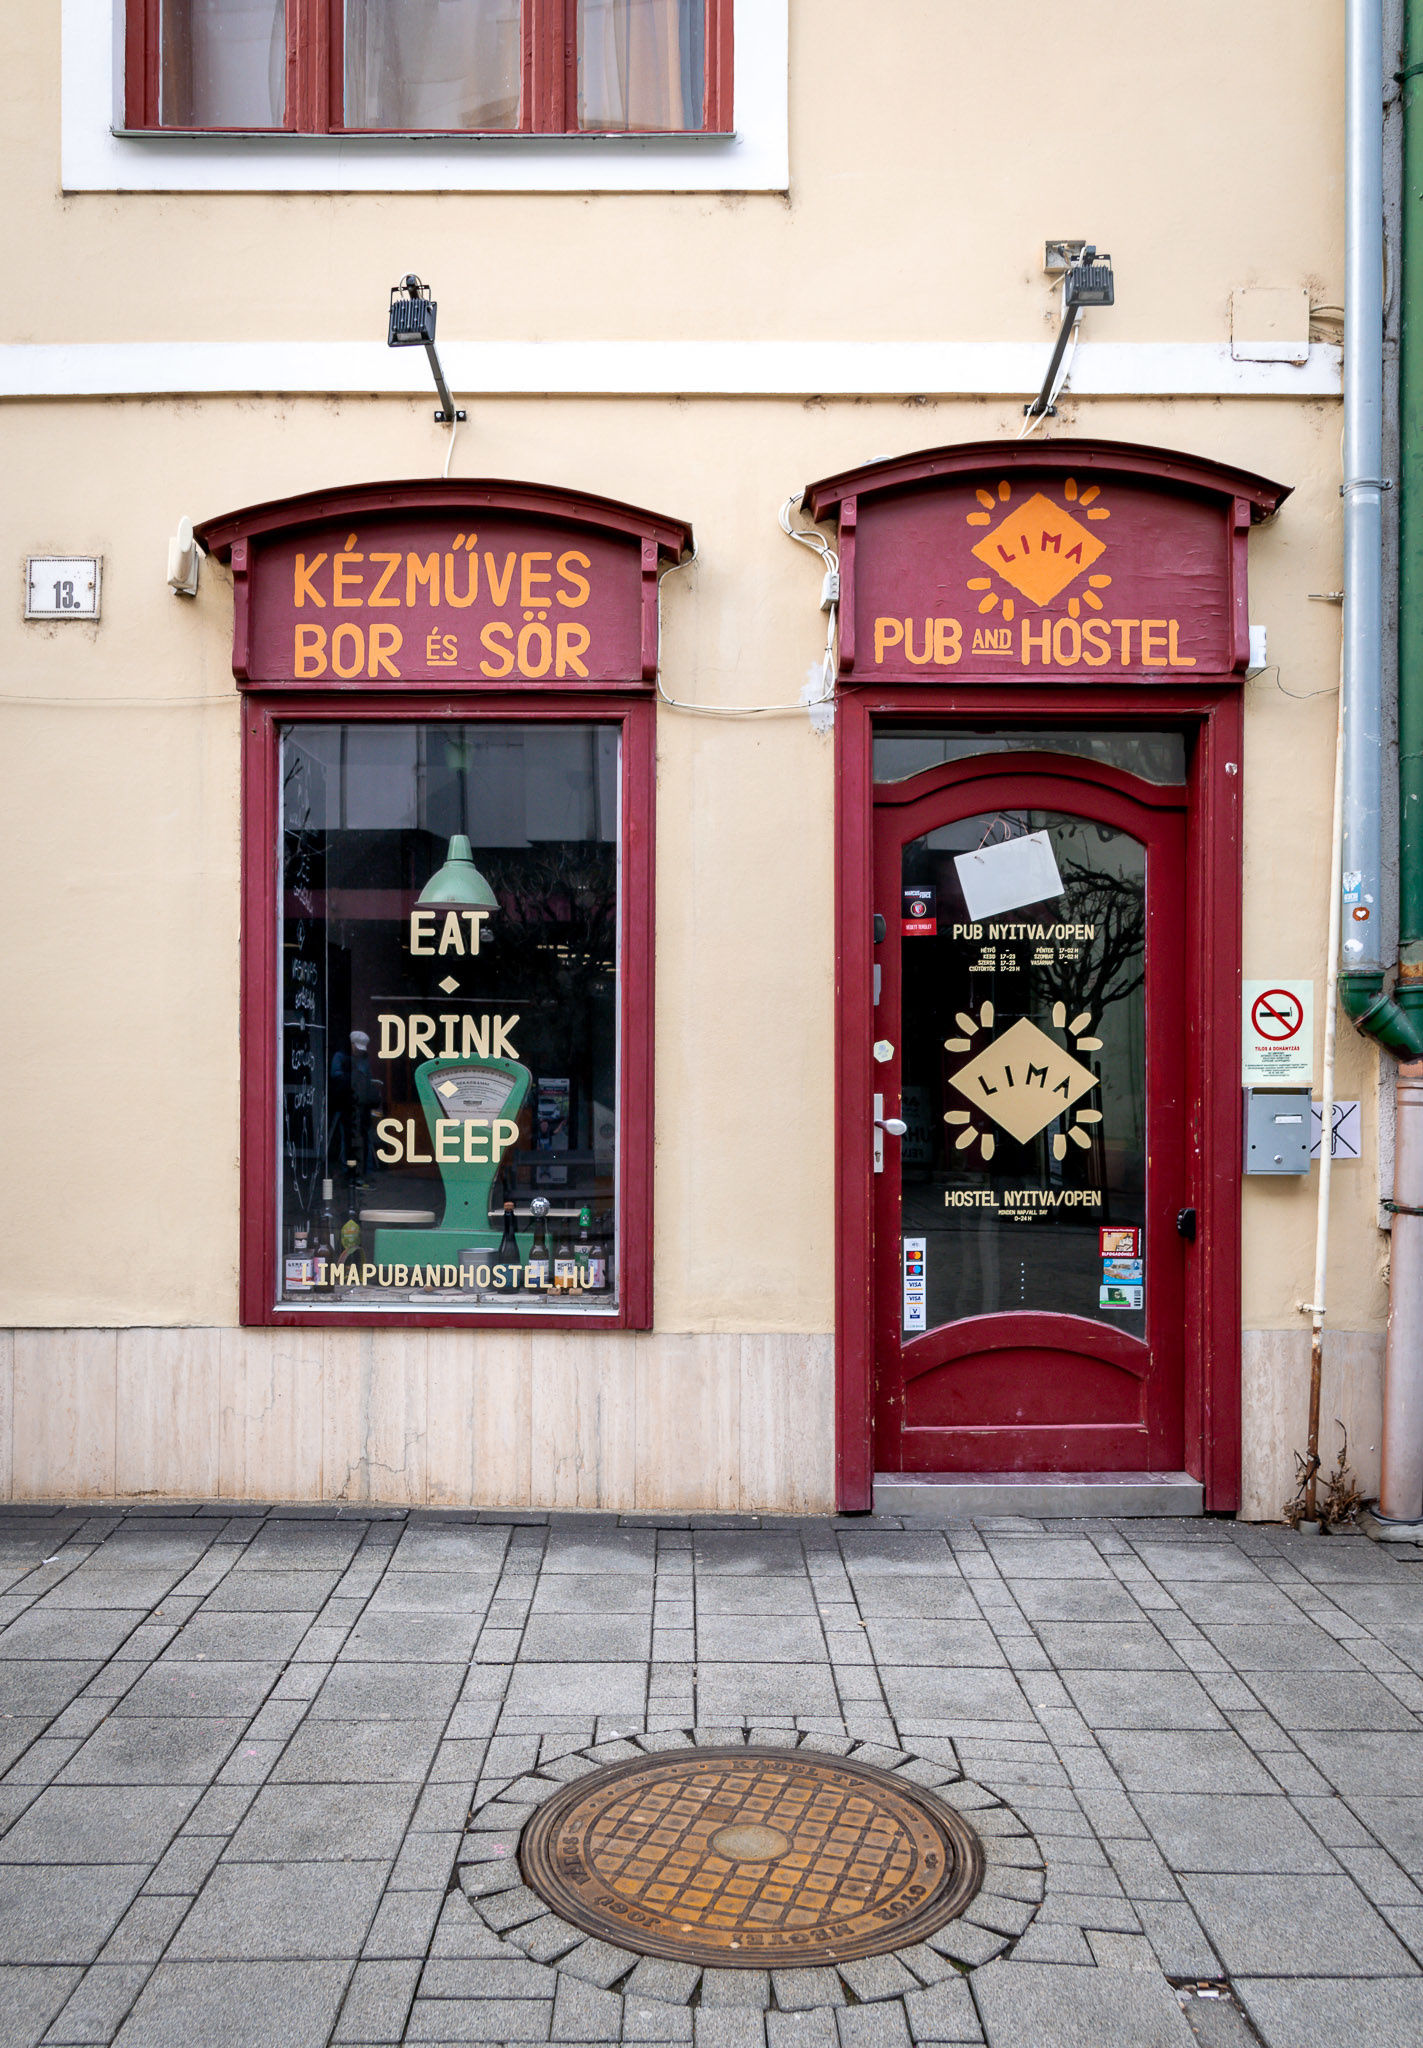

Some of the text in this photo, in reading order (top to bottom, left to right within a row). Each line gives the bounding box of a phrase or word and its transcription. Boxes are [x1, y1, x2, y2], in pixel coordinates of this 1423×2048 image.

[996, 530, 1084, 564] LIMA
[294, 533, 591, 608] KÉZMŰVES
[53, 580, 81, 609] 13.
[294, 611, 591, 678] BOR ÉS SÖR
[874, 617, 1197, 667] PUB AND HOSTEL
[410, 911, 490, 956] EAT
[953, 924, 1095, 940] PUB NYITVA/OPEN
[377, 1014, 520, 1060] DRINK
[977, 1062, 1070, 1099] LIMA
[376, 1117, 520, 1164] SLEEP
[944, 1190, 1102, 1206] HOSTEL NYITVA/OPEN
[301, 1262, 595, 1289] LIMAPUBANDHOSTEL.HU
